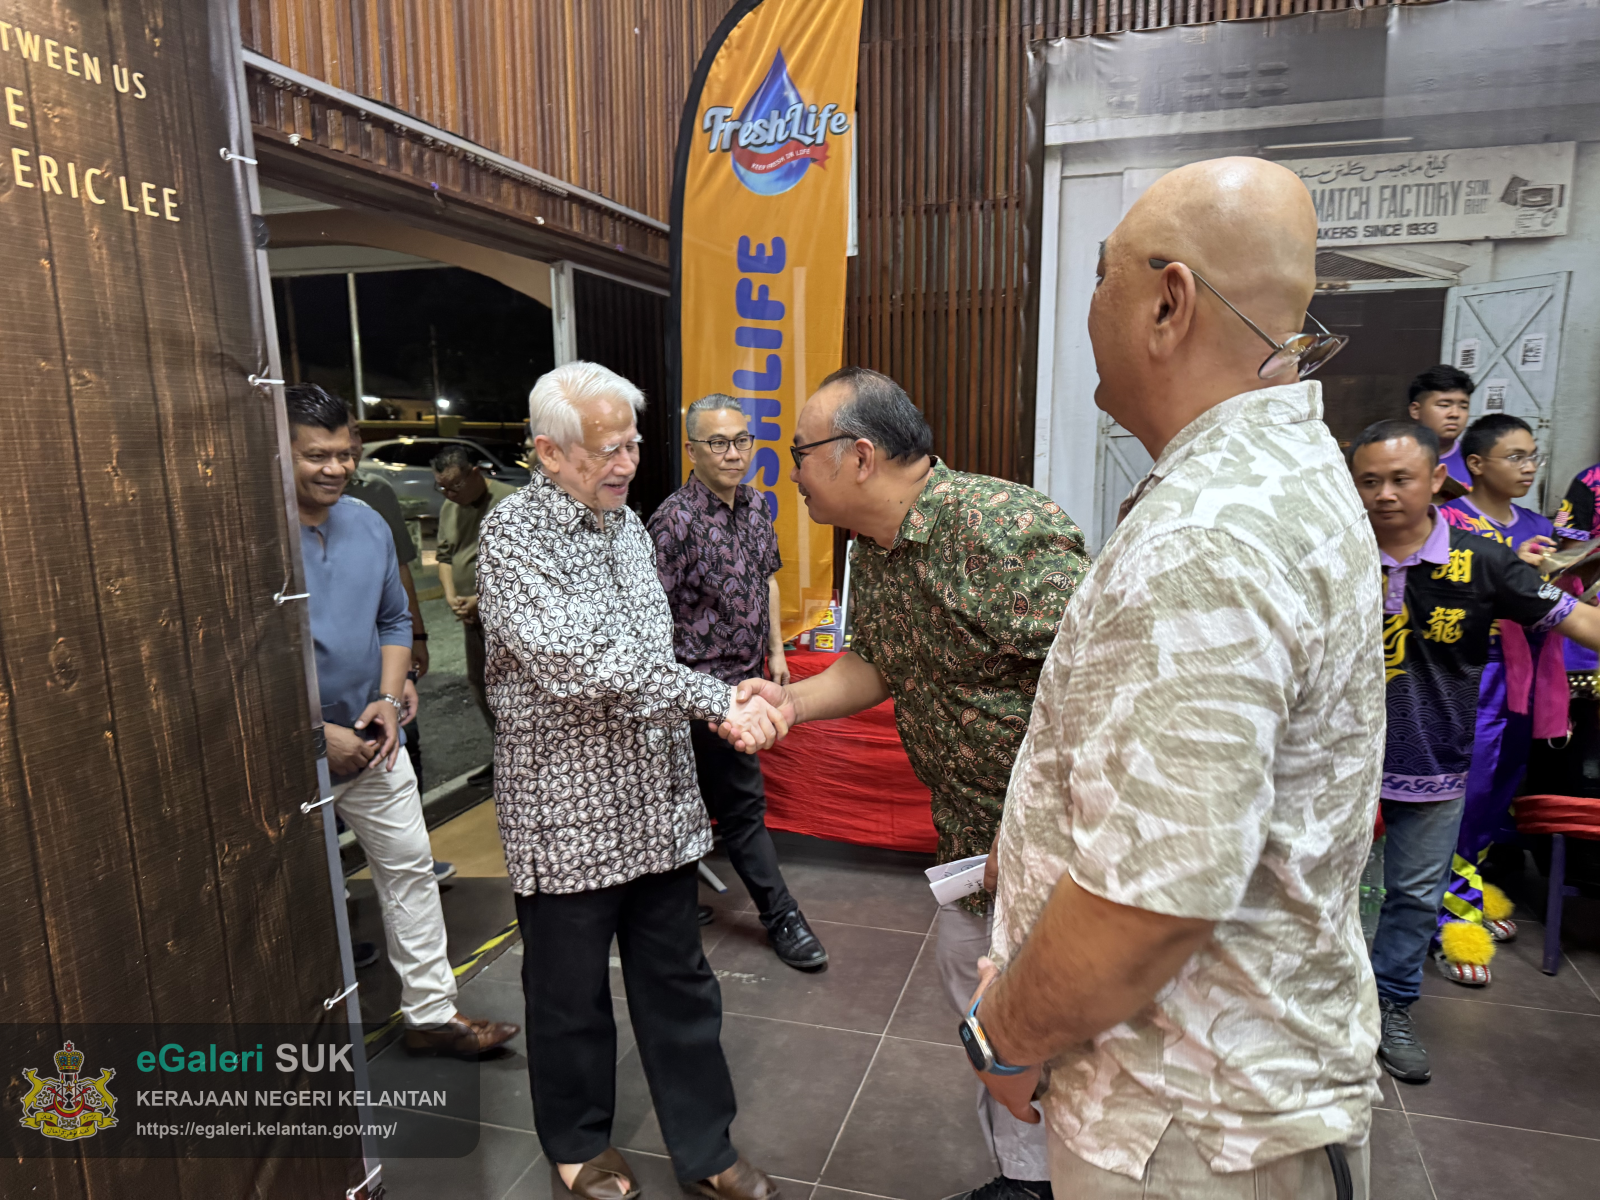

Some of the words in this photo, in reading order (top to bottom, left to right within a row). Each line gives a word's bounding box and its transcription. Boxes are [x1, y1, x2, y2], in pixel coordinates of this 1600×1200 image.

[0, 21, 102, 84] TWEEN
[113, 64, 147, 99] US
[5, 86, 28, 129] E
[702, 102, 850, 153] FreshLife
[11, 147, 106, 205] ERIC
[119, 176, 181, 222] LEE
[1312, 186, 1370, 222] MATCH
[1377, 180, 1463, 220] FACTORY
[1363, 224, 1402, 238] SINCE
[733, 235, 787, 523] SHLIFE
